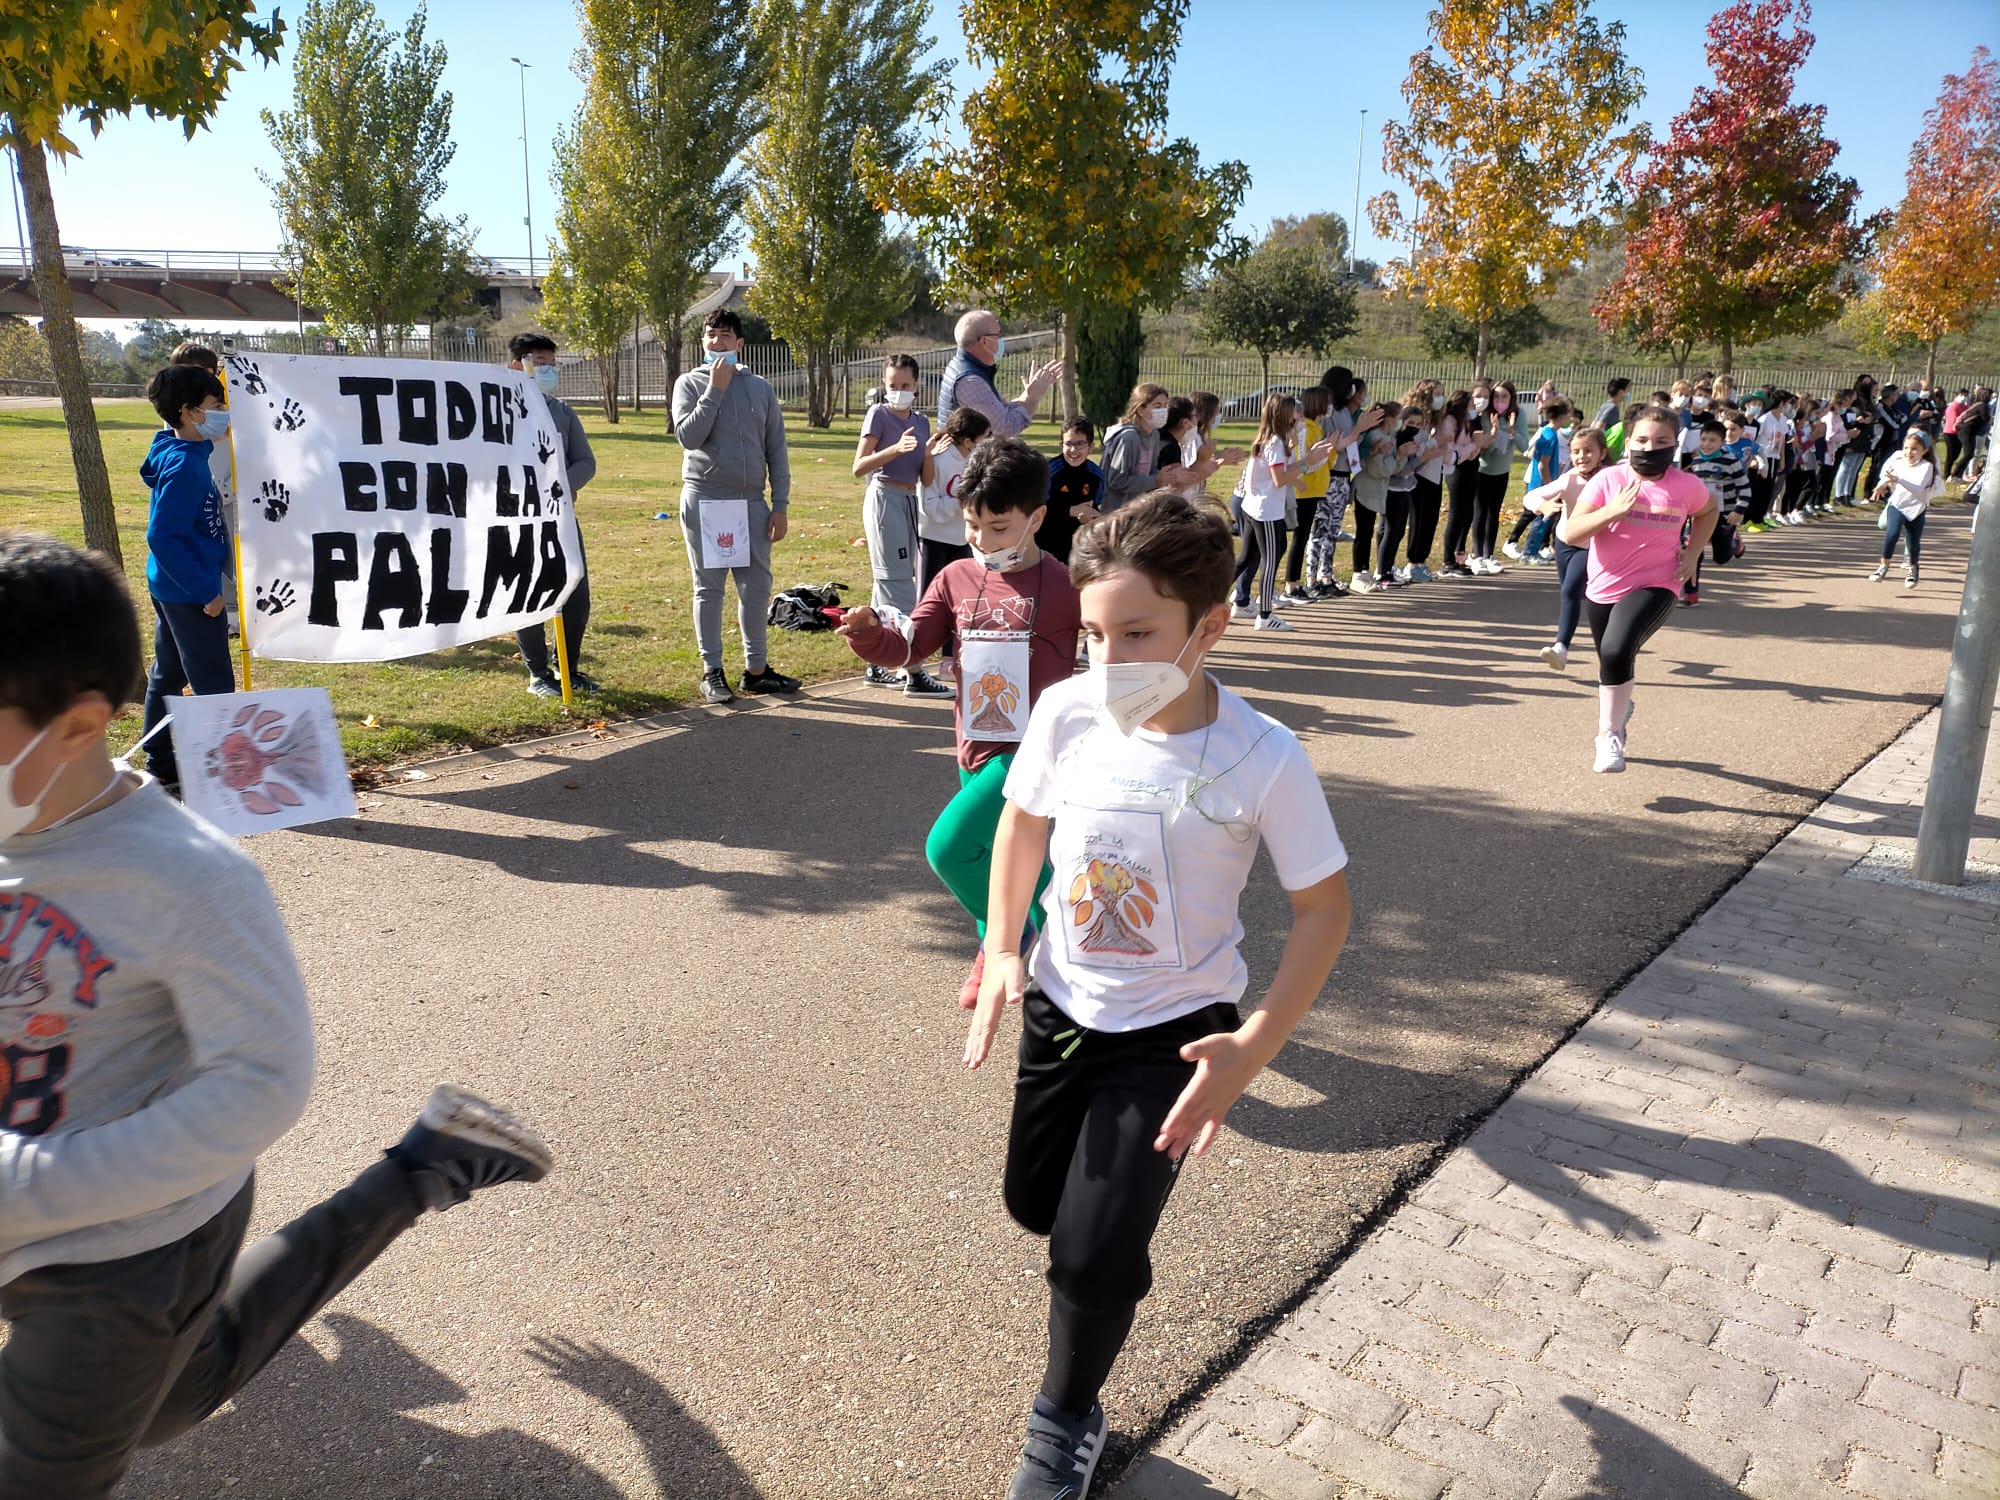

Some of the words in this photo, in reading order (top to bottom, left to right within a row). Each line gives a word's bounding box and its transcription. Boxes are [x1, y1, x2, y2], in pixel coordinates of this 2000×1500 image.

[338, 376, 515, 446] TODOS
[338, 461, 467, 519] CON
[495, 464, 542, 518] LA
[307, 520, 568, 631] PALMA
[0, 893, 117, 1008] ITY
